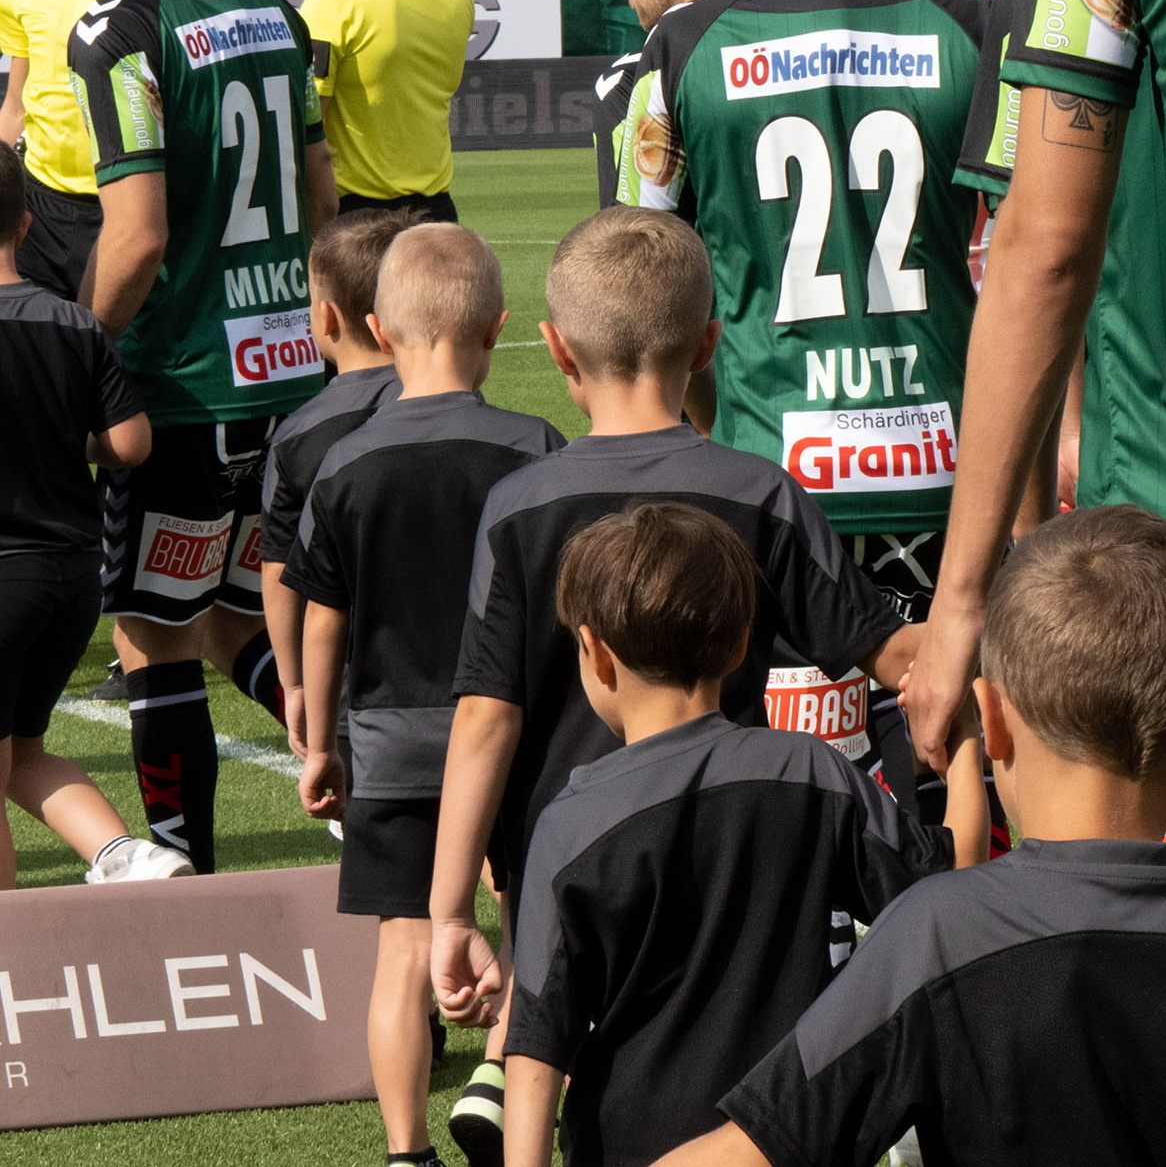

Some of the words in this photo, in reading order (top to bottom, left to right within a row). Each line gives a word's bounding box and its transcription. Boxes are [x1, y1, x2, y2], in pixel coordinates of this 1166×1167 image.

[185, 18, 292, 60] OÖNachrichten
[729, 42, 934, 88] OÖNachrichten
[220, 75, 299, 247] 21
[756, 109, 927, 324] 22
[234, 329, 325, 382] Grani
[806, 344, 926, 401] NUTZ
[836, 407, 946, 430] Schärdinger
[787, 429, 957, 490] Granit
